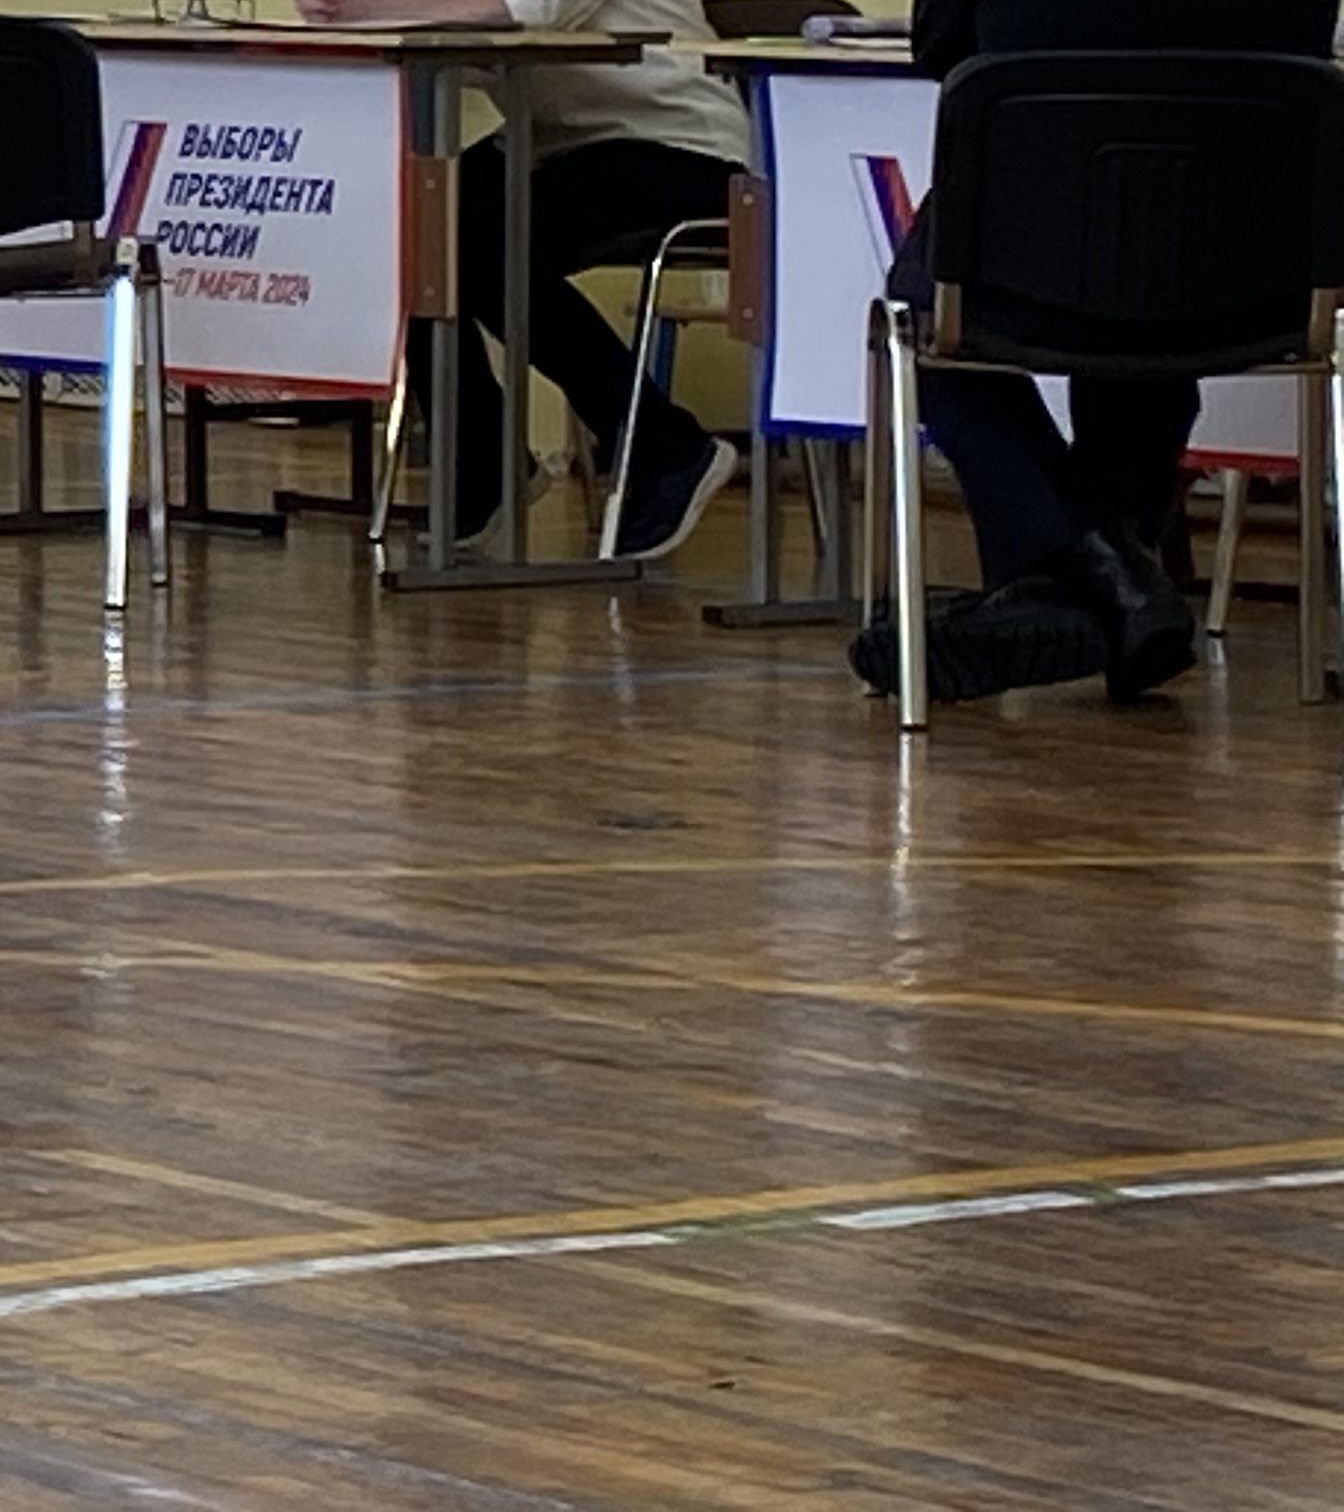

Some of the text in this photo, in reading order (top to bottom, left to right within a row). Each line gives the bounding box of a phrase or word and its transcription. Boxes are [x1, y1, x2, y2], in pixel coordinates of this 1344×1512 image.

[178, 123, 303, 164] ВЫБОРЫ
[164, 172, 336, 216] ПРЕЗИДЕНТА
[155, 219, 261, 260] РОССИИ
[198, 270, 260, 303] МАРТА
[263, 273, 311, 307] 2024
